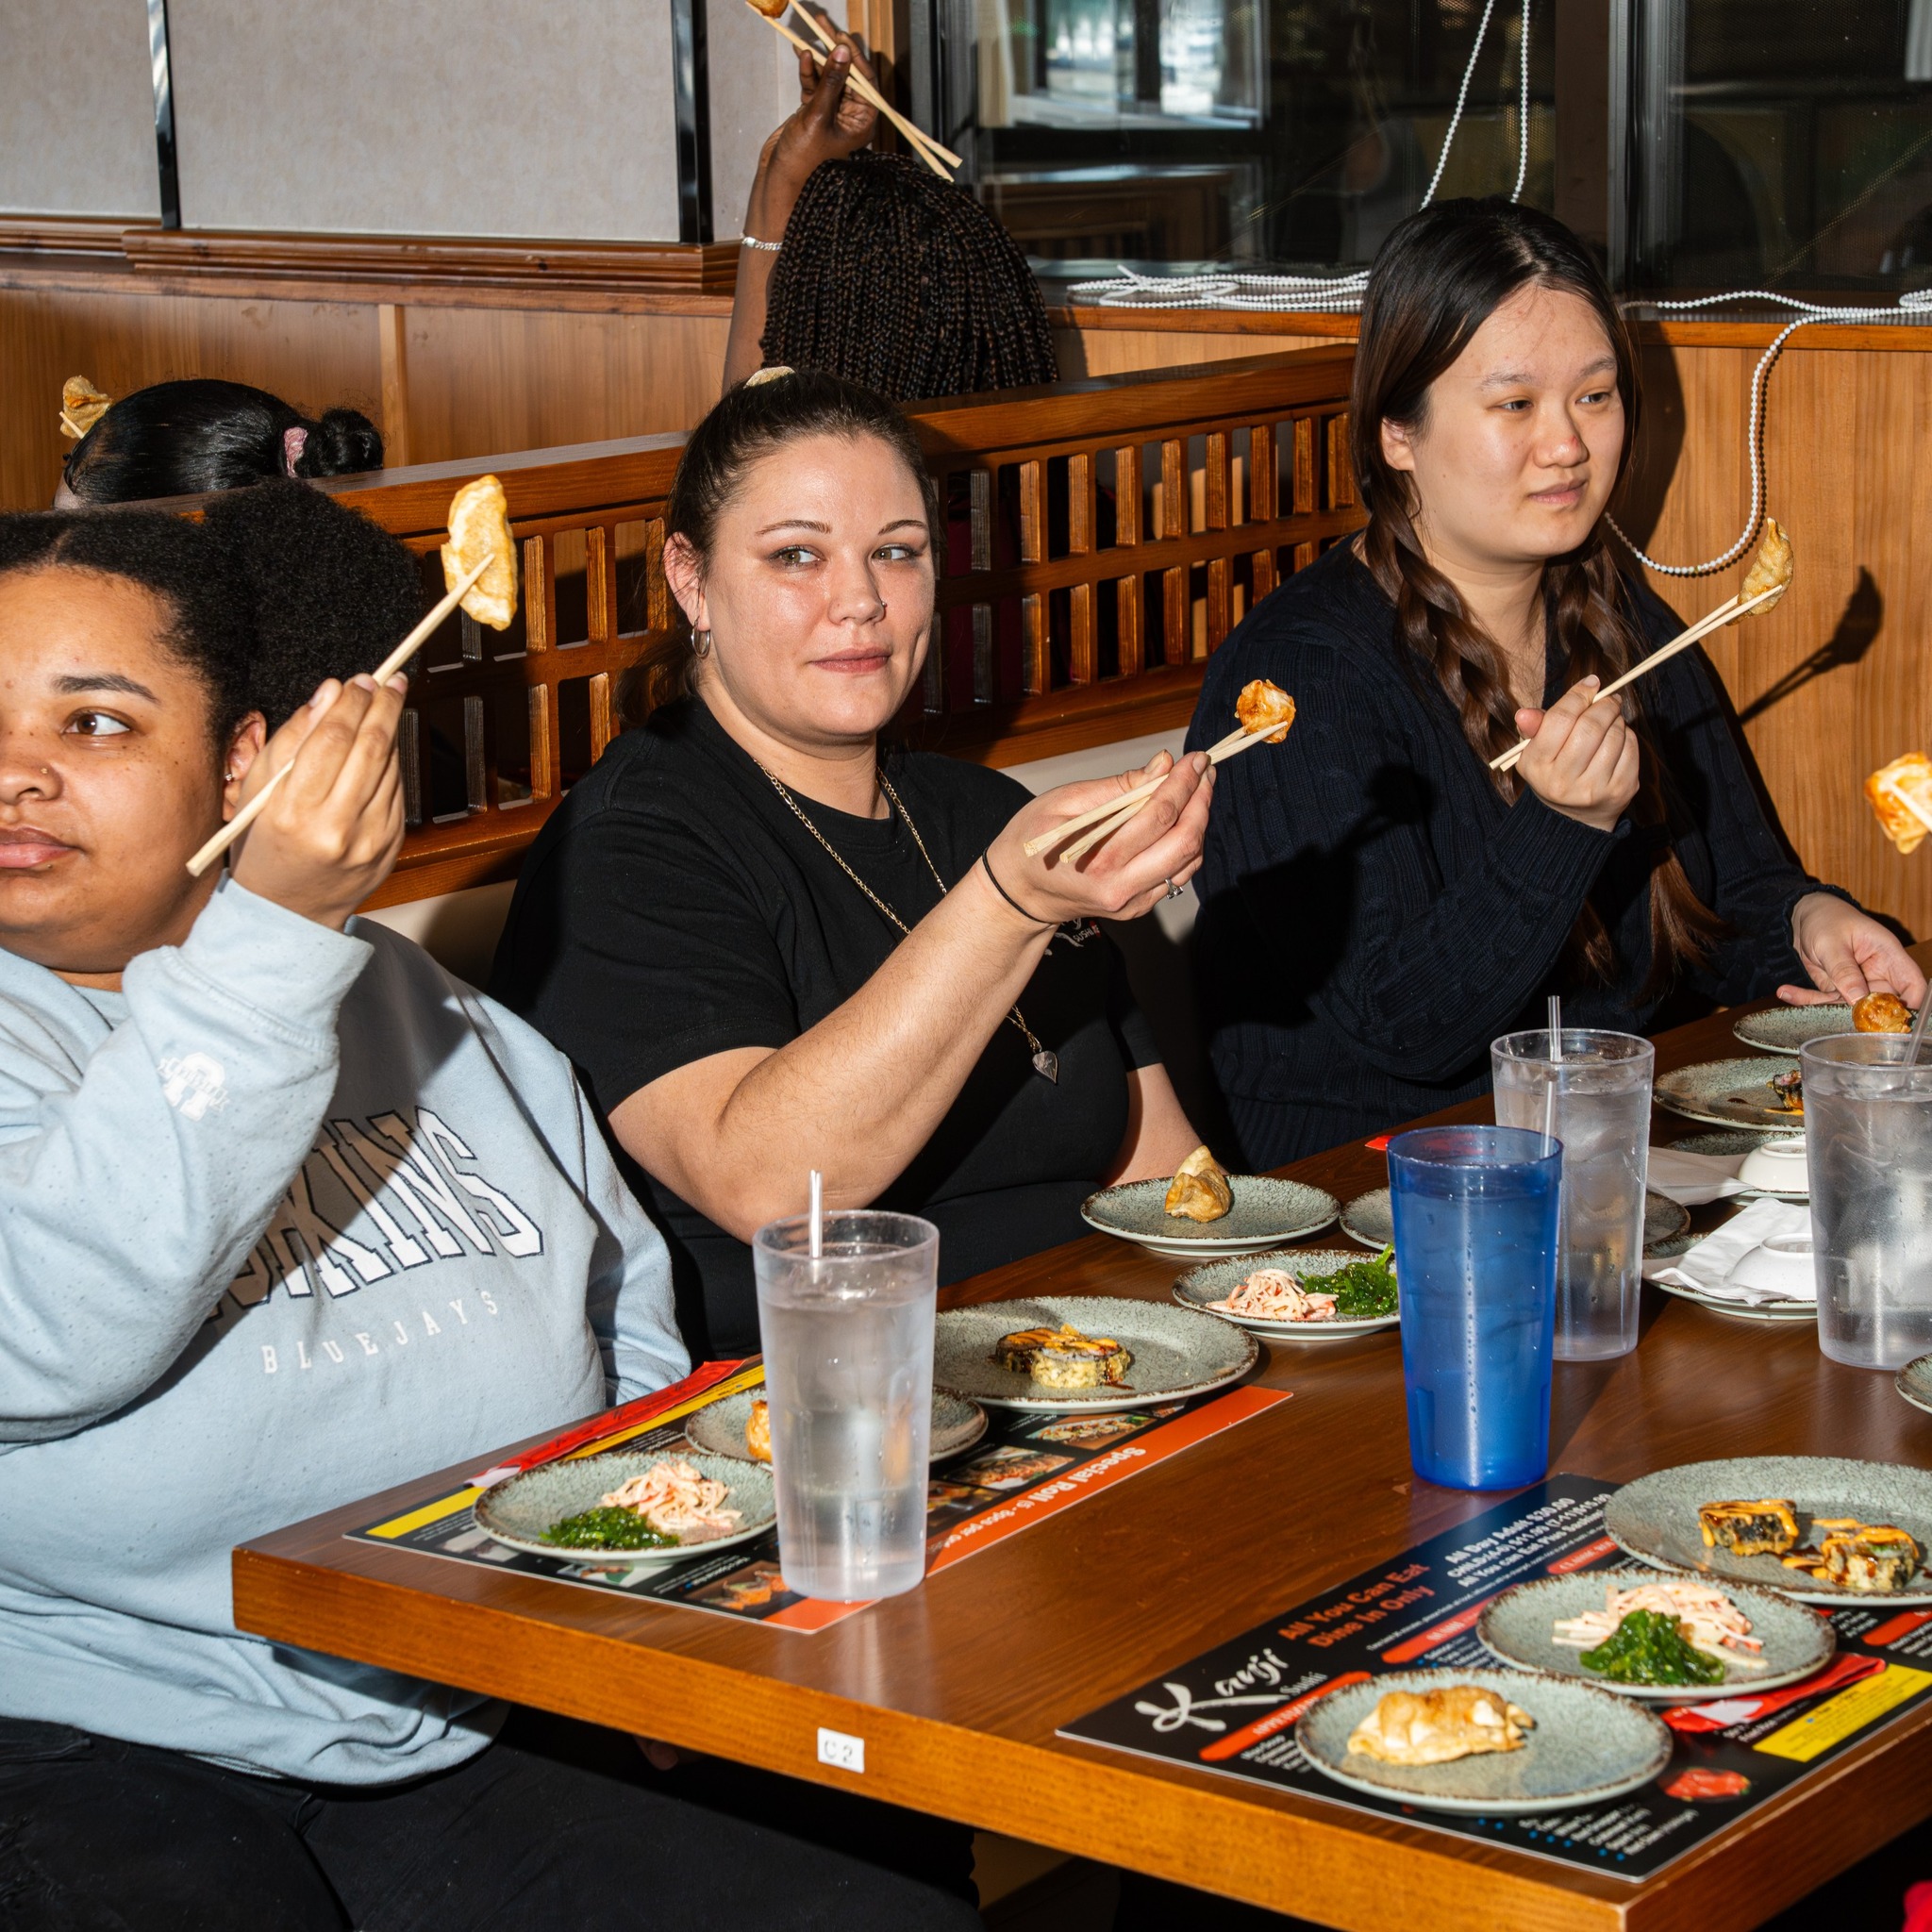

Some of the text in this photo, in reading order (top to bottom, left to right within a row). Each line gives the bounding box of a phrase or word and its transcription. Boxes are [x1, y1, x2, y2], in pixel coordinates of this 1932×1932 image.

[1073, 927, 1094, 942] SUSHI
[195, 1105, 544, 1321] KINS
[1068, 1446, 1146, 1483] Special
[1027, 1481, 1077, 1503] Roll
[1444, 1550, 1472, 1564] All
[1463, 1537, 1500, 1553] Day
[1491, 1519, 1535, 1541] Adult
[1457, 1575, 1480, 1589] All
[1473, 1564, 1502, 1577] You
[1517, 1542, 1544, 1556] Eat
[1536, 1530, 1568, 1545] Plus
[1277, 1563, 1431, 1641] All You Can Eat
[1307, 1622, 1364, 1648] Dine
[1354, 1609, 1388, 1624] In
[1379, 1585, 1436, 1610] Only
[1135, 1648, 1290, 1733] Kanji
[1279, 1671, 1328, 1695] Sushi
[842, 1744, 854, 1765] 2
